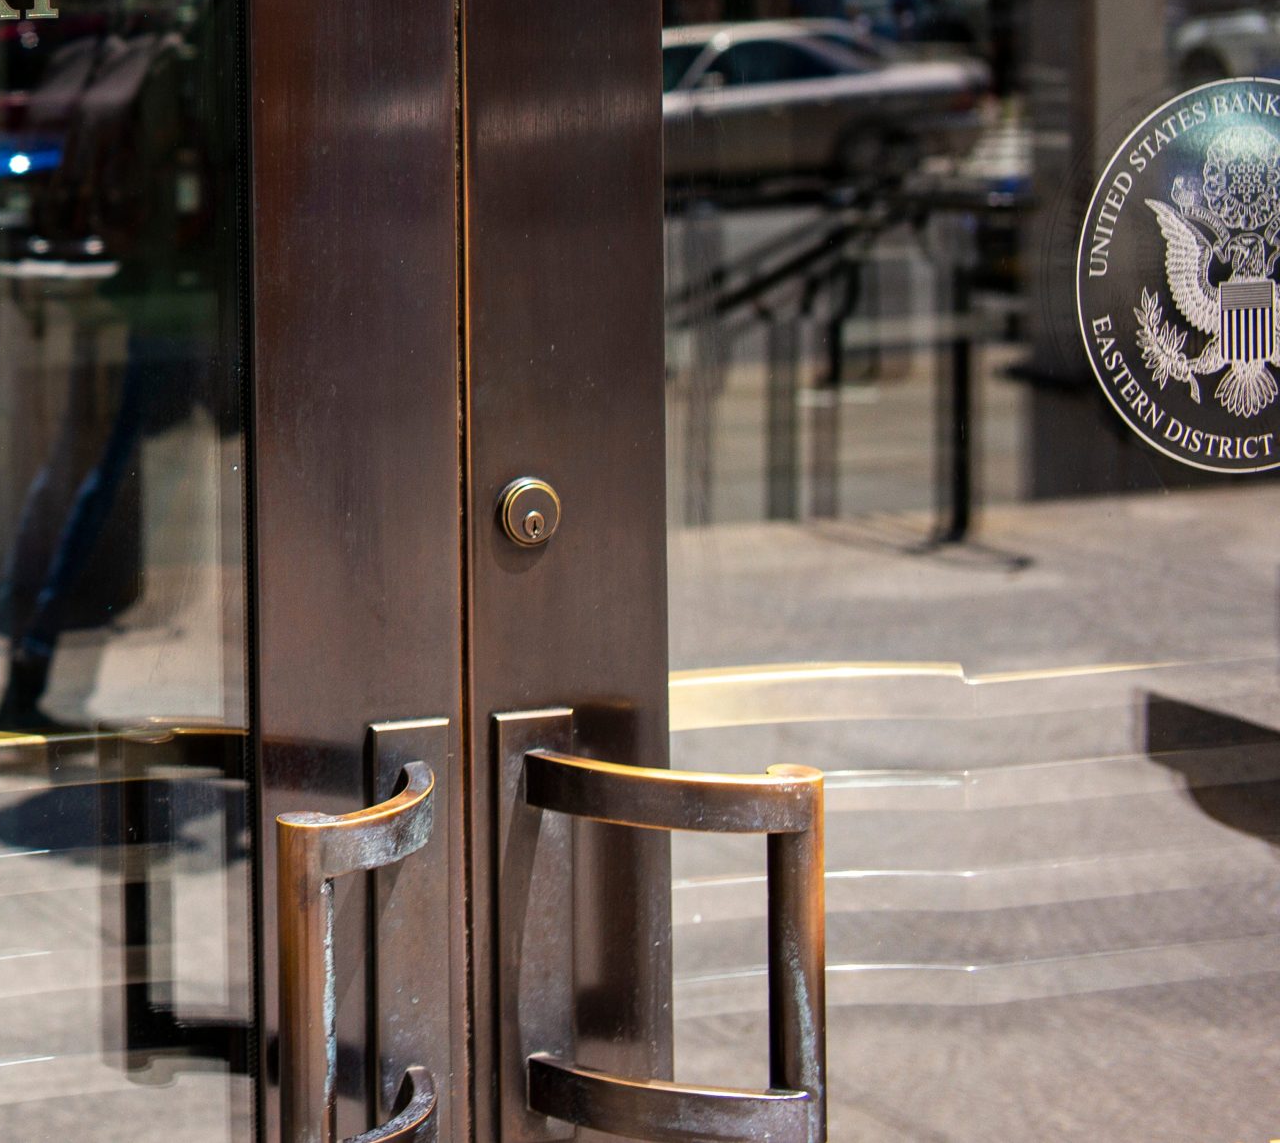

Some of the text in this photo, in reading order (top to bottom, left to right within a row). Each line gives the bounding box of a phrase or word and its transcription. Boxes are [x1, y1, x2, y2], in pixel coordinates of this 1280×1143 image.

[1089, 170, 1134, 278] UNITED
[1129, 100, 1207, 174] STATES
[1091, 313, 1273, 459] EASTERN DISTRICT
